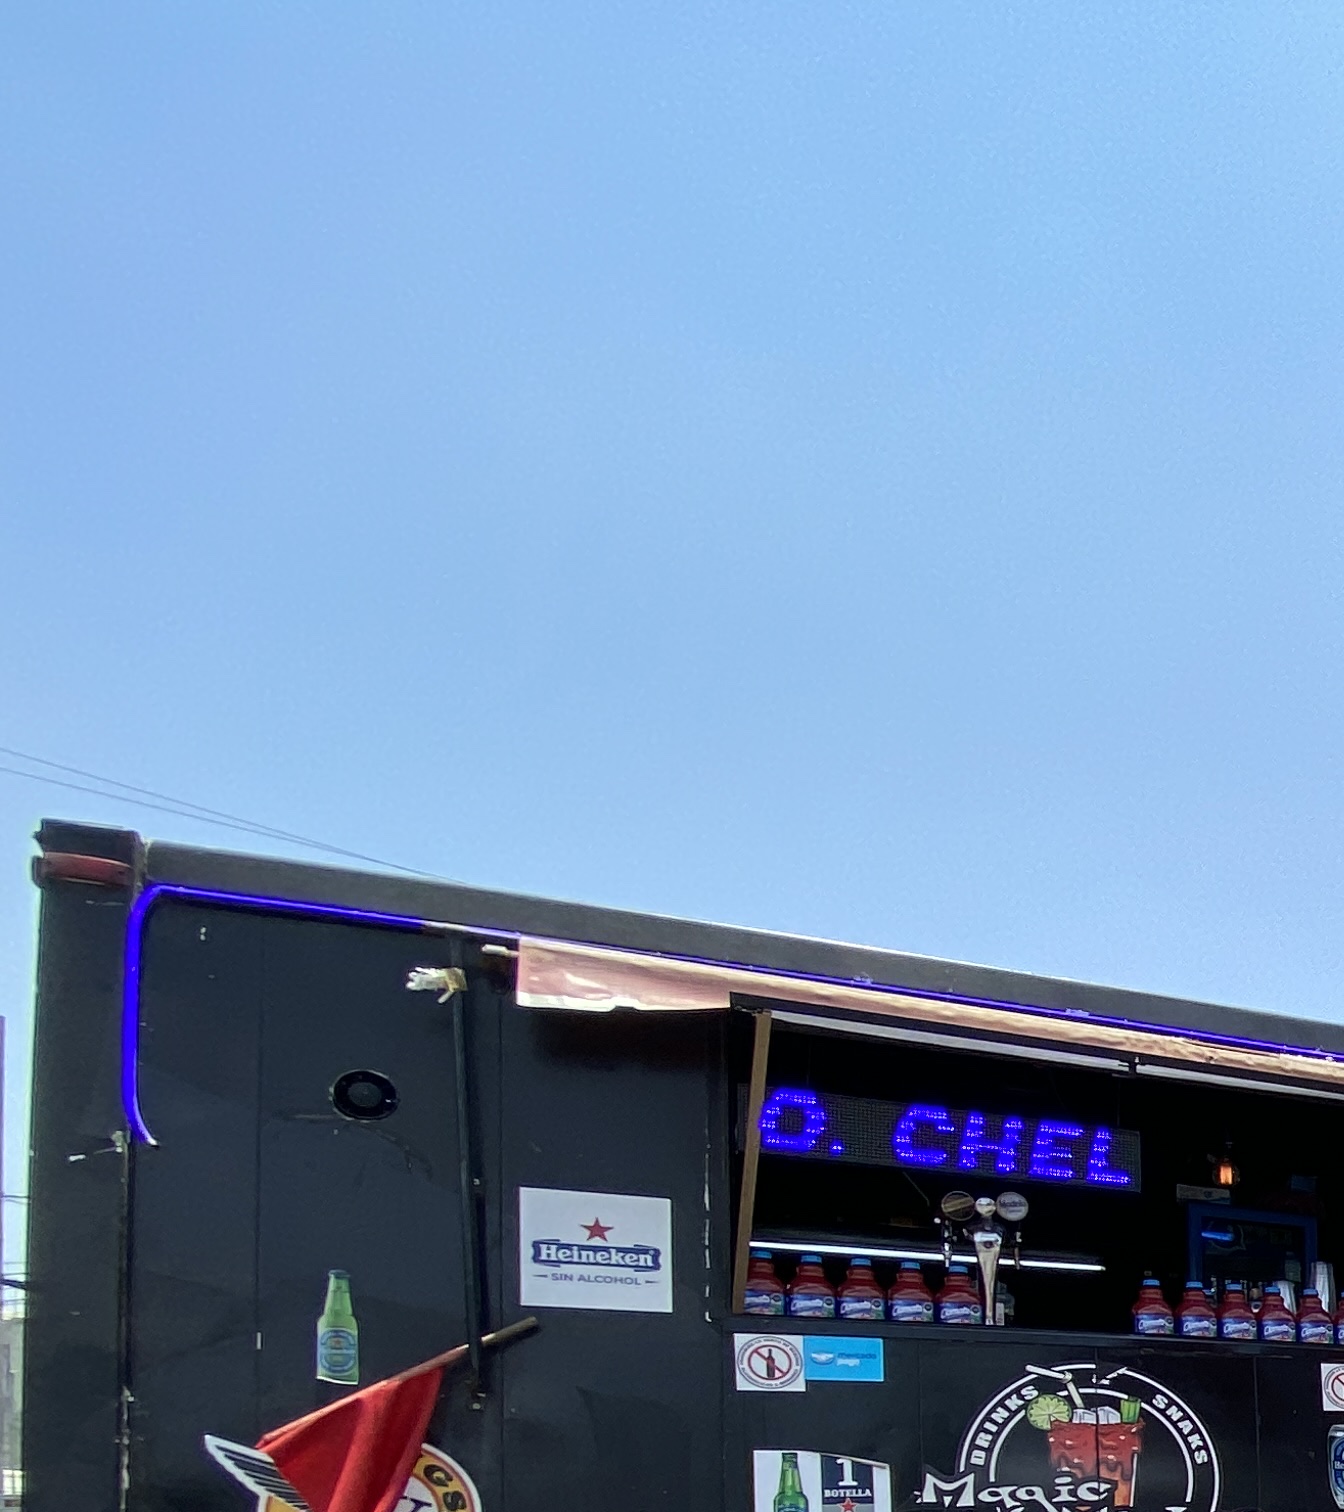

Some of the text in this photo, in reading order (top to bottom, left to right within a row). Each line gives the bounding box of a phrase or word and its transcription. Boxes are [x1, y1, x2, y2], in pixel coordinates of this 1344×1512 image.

[892, 1102, 1132, 1186] CHEL
[539, 1243, 655, 1267] Heineken
[552, 1273, 642, 1286] SIN ALCOHOL
[969, 1384, 1039, 1467] DRINKS
[1151, 1393, 1209, 1466] SNAKS
[836, 1458, 858, 1486] 1
[824, 1488, 872, 1498] BOTELLA
